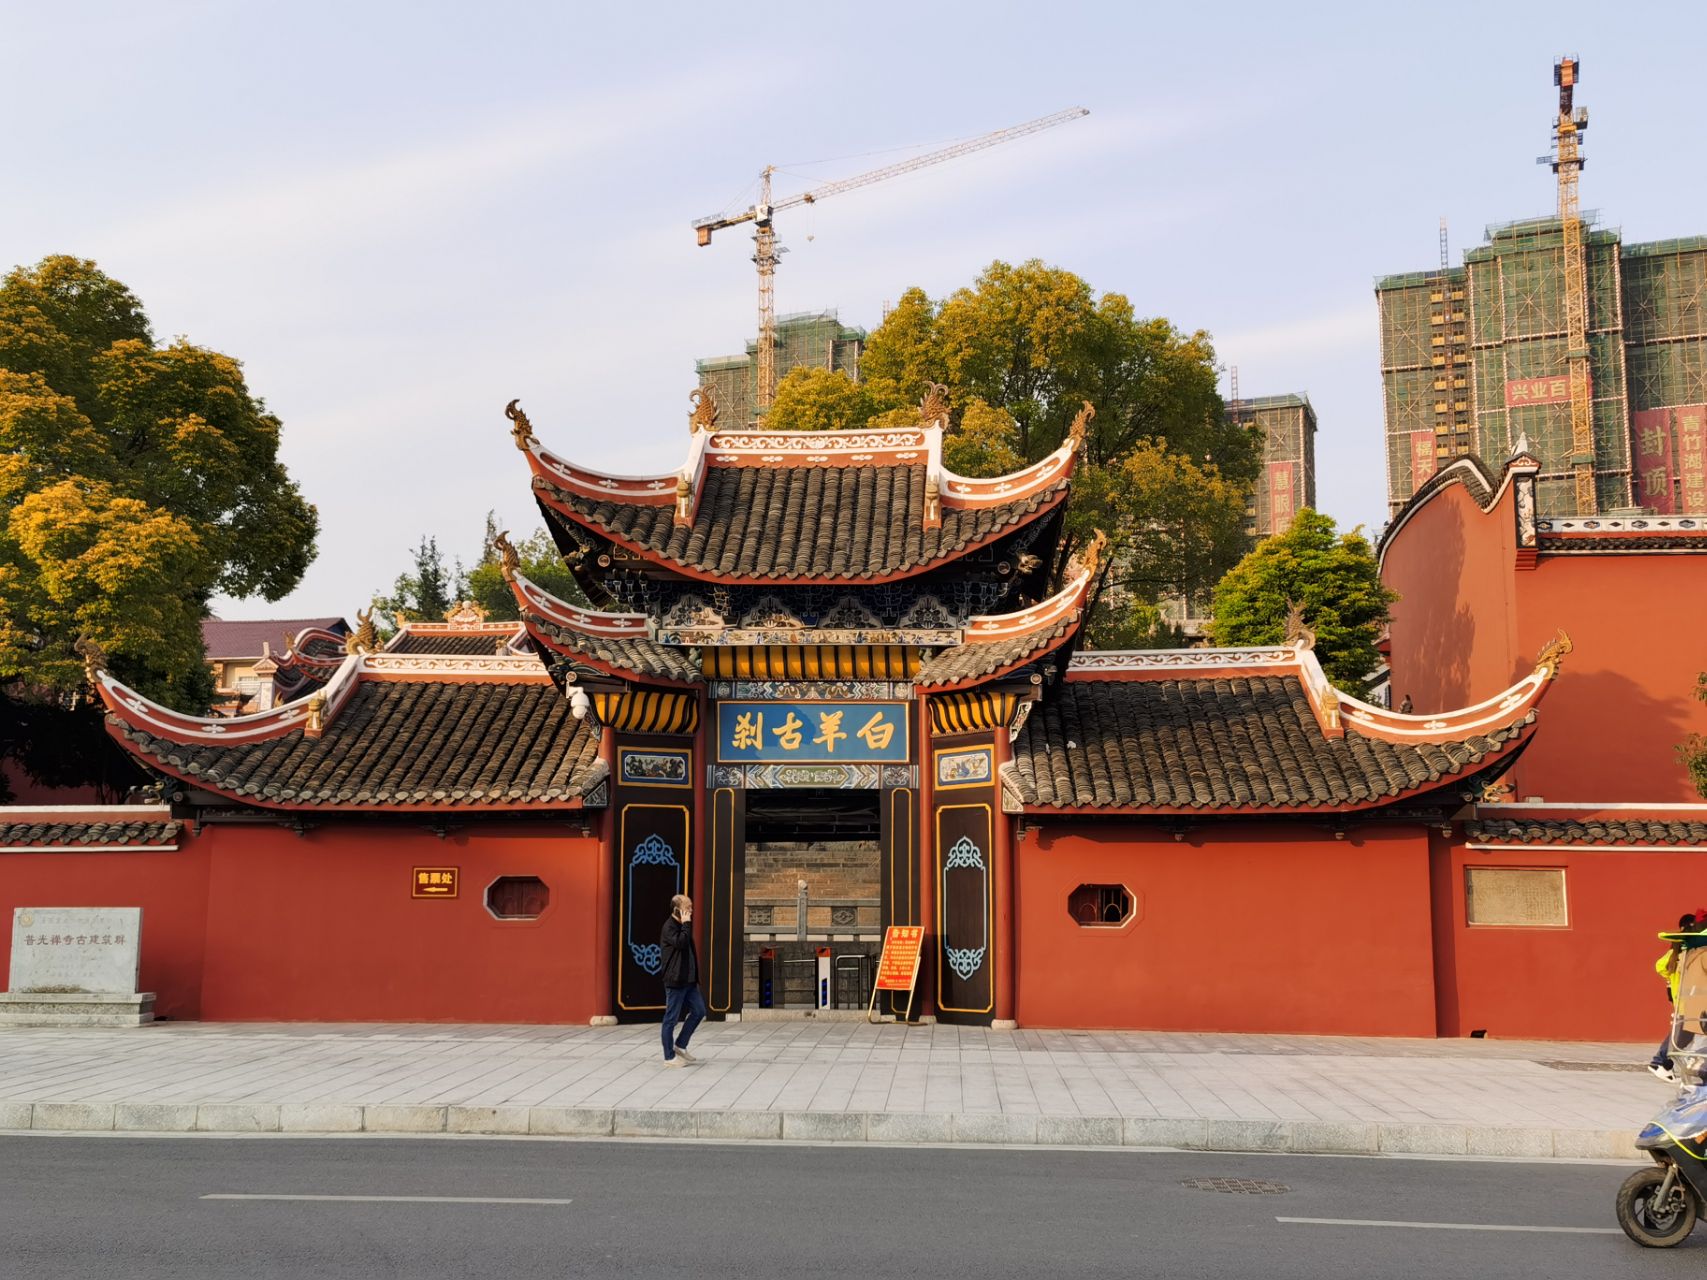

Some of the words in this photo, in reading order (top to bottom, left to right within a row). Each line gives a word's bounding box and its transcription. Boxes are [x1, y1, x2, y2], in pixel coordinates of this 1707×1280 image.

[1511, 379, 1587, 401] 兴业百
[1415, 440, 1433, 488] 福天
[1640, 425, 1668, 514] 封顶
[1682, 415, 1705, 512] 青竹湖建设
[418, 872, 453, 884] 售票处
